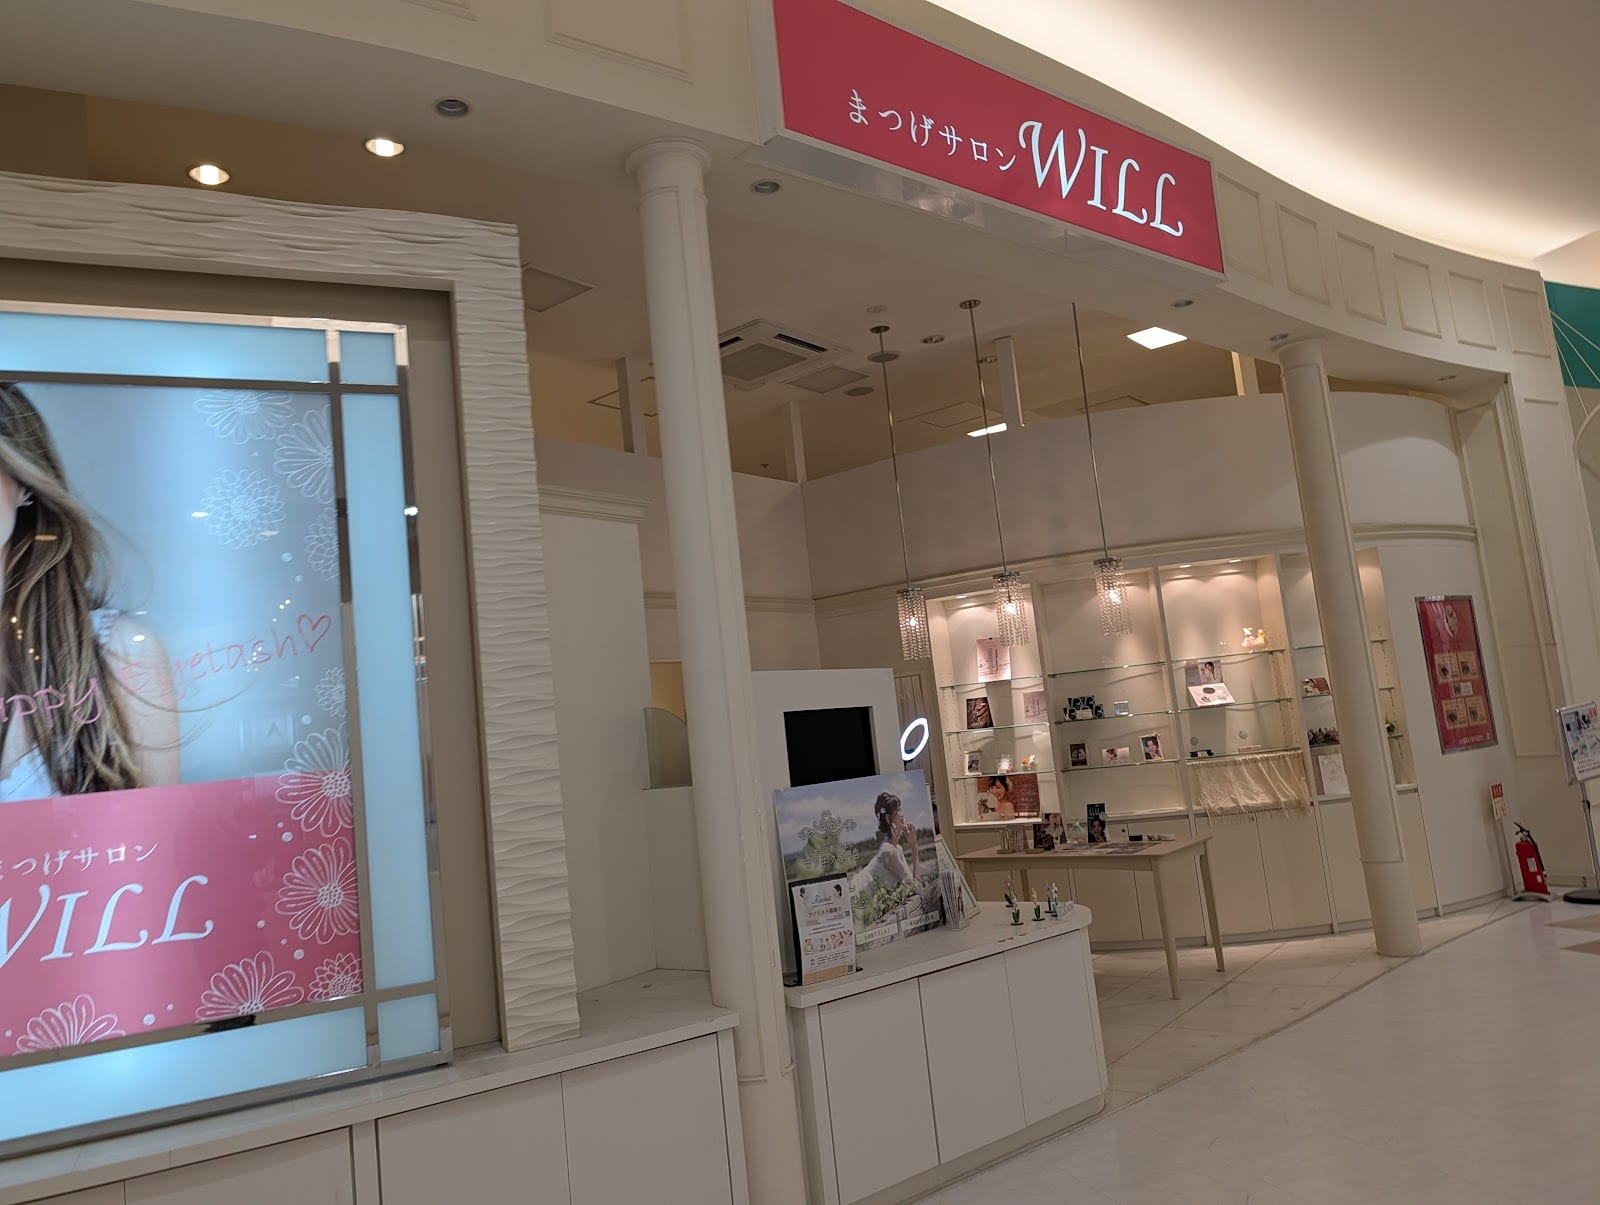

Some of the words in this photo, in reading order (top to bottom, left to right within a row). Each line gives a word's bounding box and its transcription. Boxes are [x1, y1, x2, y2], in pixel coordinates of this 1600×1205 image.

[847, 89, 1016, 171] まつげサロン
[1018, 120, 1183, 237] WILL
[0, 677, 103, 730] ppy
